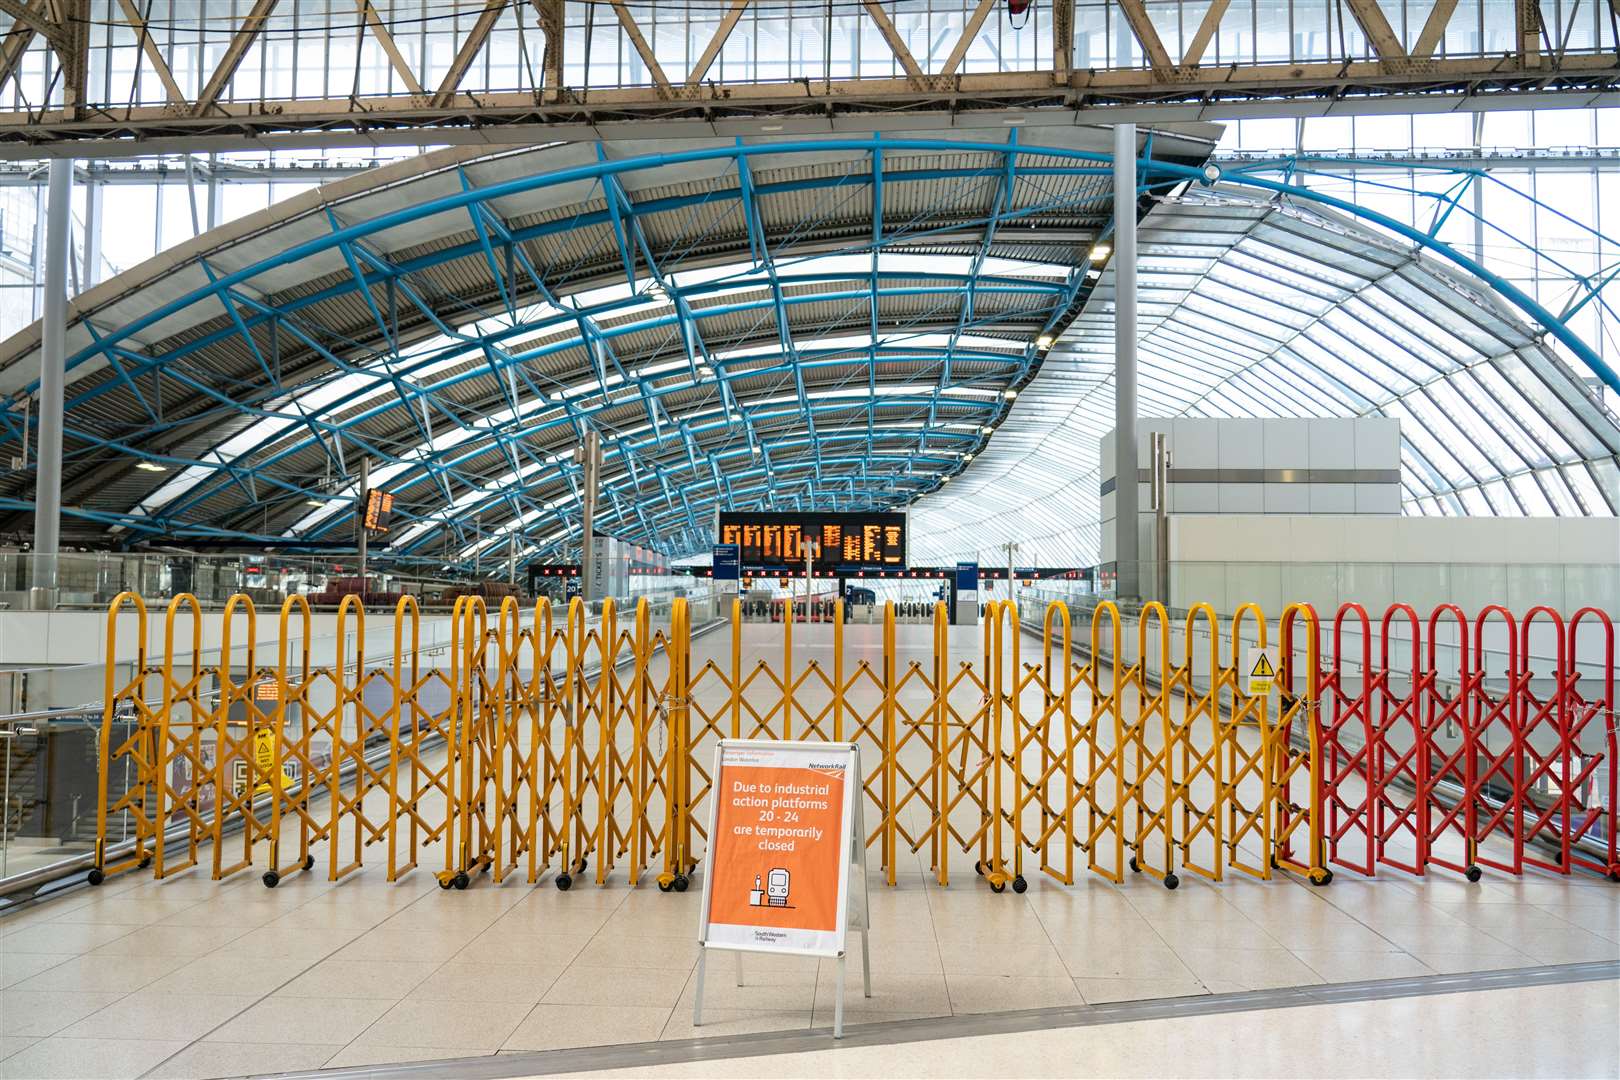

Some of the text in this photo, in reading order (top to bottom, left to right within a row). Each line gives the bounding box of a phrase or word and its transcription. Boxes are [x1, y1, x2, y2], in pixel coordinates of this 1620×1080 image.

[733, 781, 830, 795] Due to industrial
[732, 796, 828, 810] action platforms
[759, 810, 774, 822] 20
[783, 811, 800, 823] 24
[733, 825, 823, 841] are temporarily
[758, 839, 795, 852] closed
